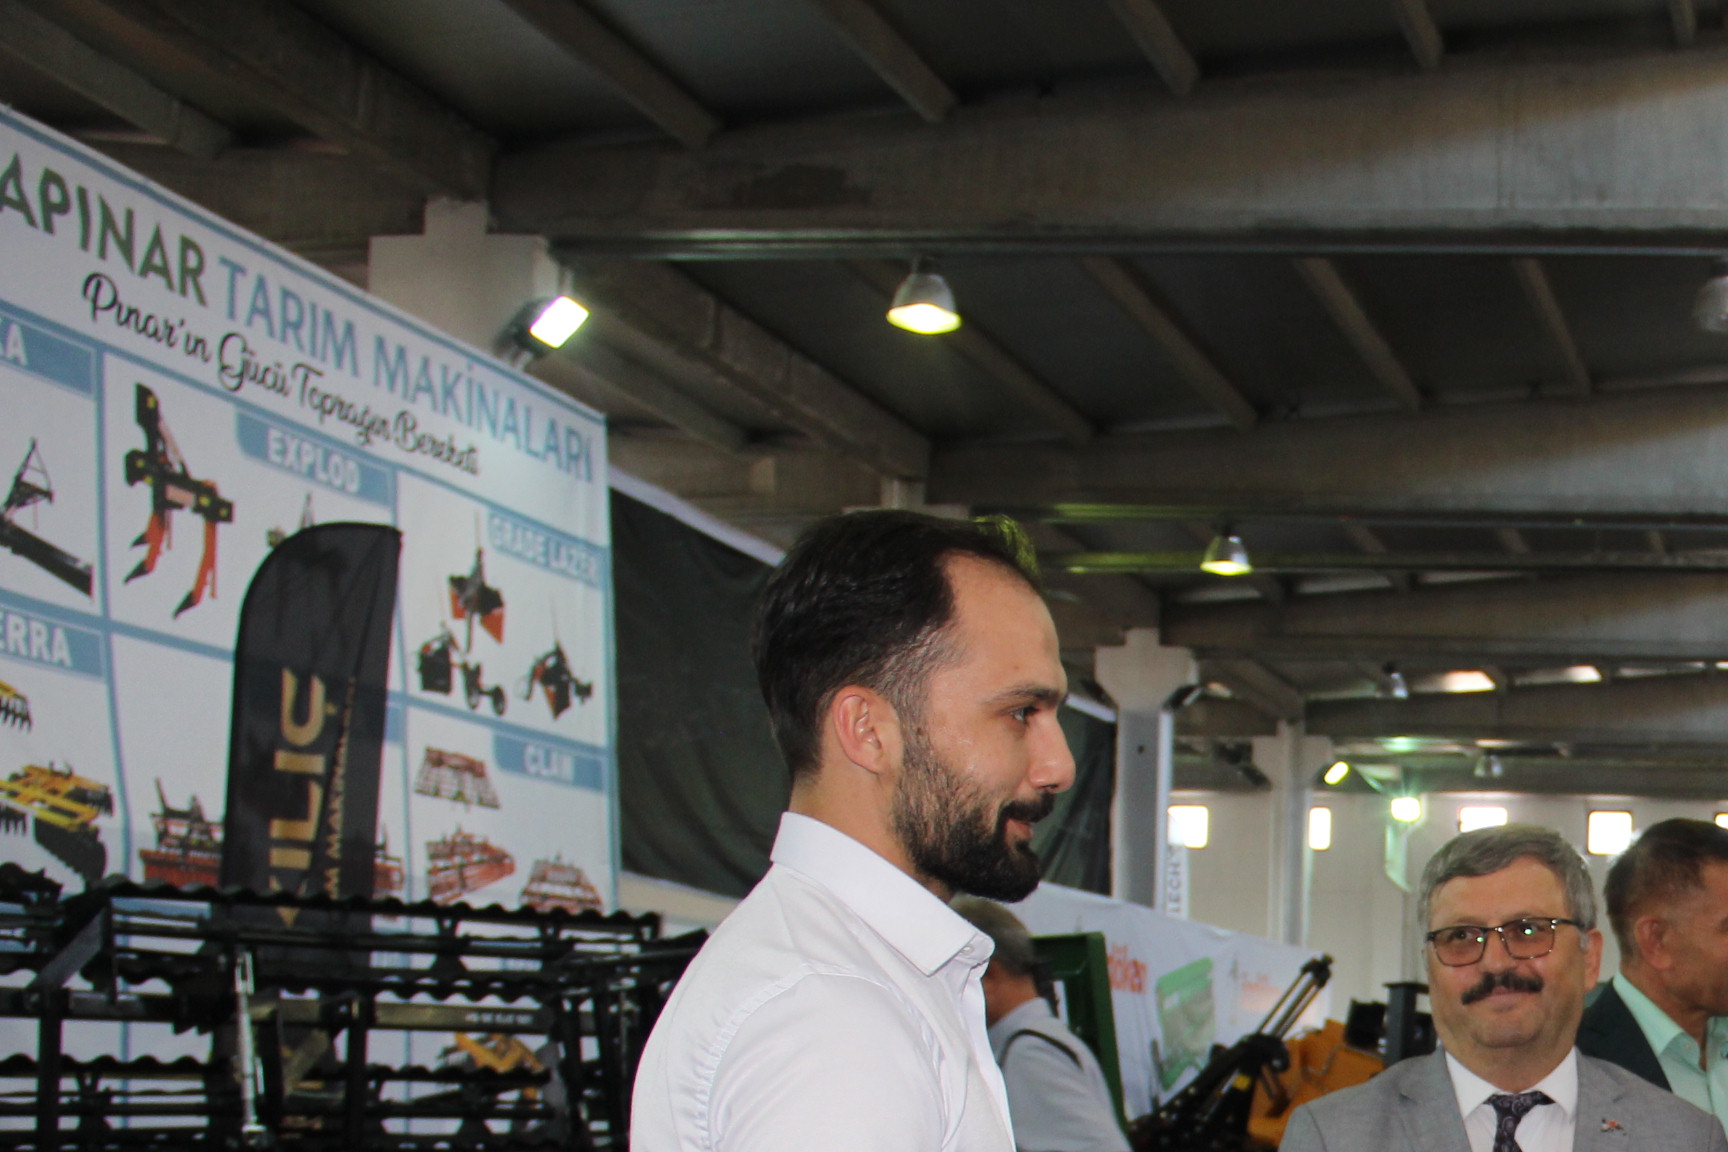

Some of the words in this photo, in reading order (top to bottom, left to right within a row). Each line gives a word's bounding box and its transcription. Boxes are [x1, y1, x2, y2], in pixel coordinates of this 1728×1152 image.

[218, 254, 360, 378] TARIM
[373, 333, 595, 484] MAKİNALARI
[0, 611, 73, 668] RRA
